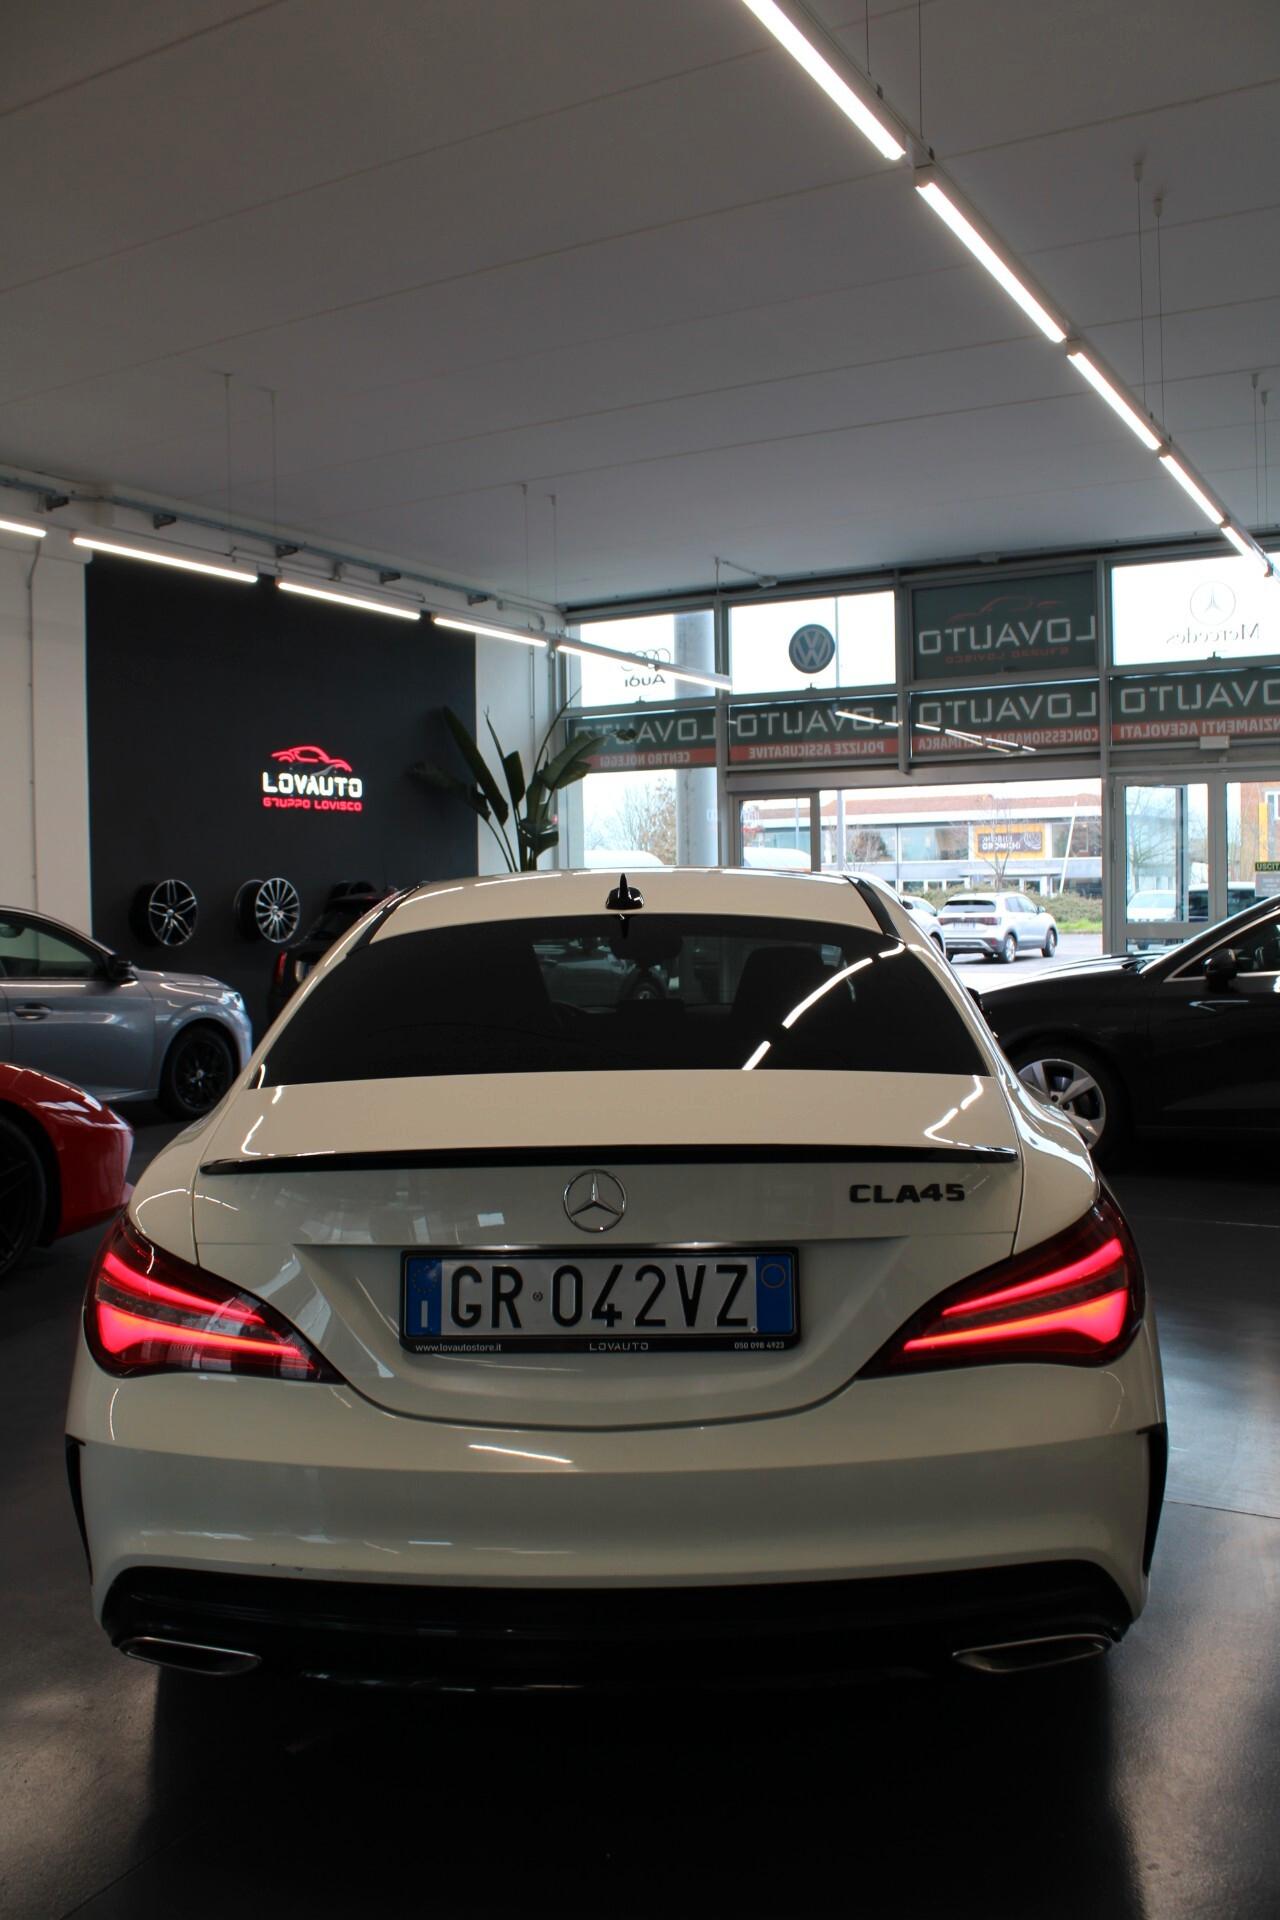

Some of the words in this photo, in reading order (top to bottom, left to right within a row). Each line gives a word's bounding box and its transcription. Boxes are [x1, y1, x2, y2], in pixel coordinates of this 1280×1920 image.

[262, 771, 363, 798] LOVAUTO
[314, 800, 362, 812] LOVISCO
[1256, 863, 1280, 871] USCIT
[849, 1183, 966, 1203] CLA45
[415, 1343, 502, 1352] www.lovautostore.it
[589, 1342, 649, 1351] LOVAUTO
